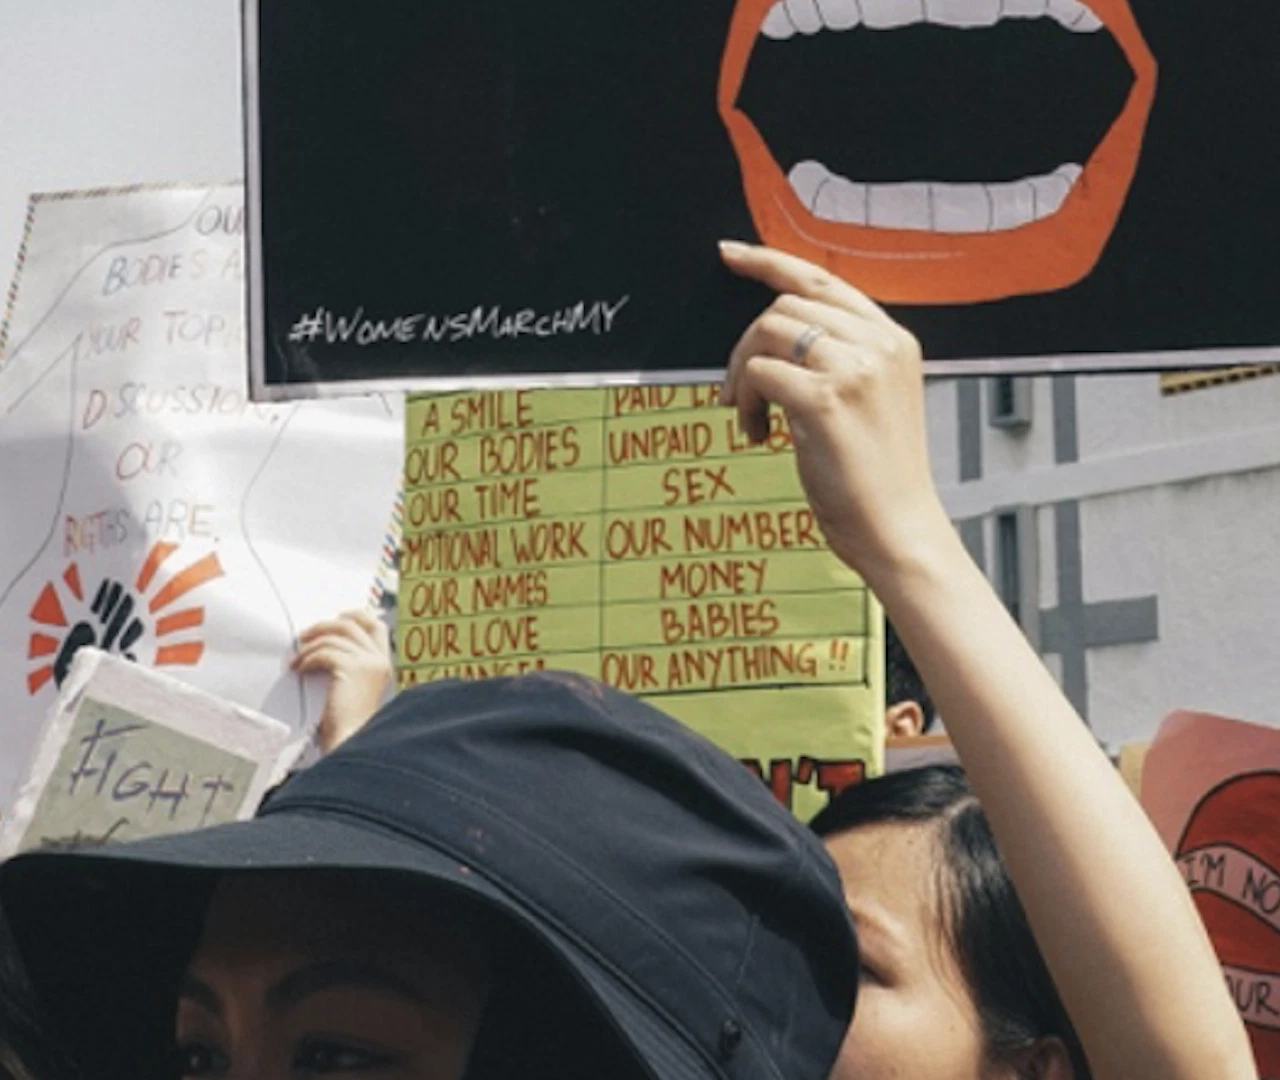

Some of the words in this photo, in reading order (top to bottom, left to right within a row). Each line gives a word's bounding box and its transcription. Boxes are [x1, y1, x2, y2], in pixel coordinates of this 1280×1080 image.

[102, 248, 209, 296] BODIES
[422, 402, 440, 437] A
[451, 389, 534, 436] SMILE
[615, 385, 678, 418] PAID
[405, 439, 462, 486] OUR
[480, 426, 580, 475] BODIES
[609, 422, 713, 464] UNPAID
[409, 488, 462, 527] OUR
[475, 478, 541, 519] TIME
[661, 466, 735, 505] SEX
[511, 521, 588, 566] WORK
[606, 516, 673, 560] OUR
[410, 577, 462, 618] OUR
[472, 570, 548, 616] NAMES
[660, 558, 767, 599] MONEY
[405, 622, 462, 663] OUR
[471, 616, 539, 657] LOVE
[659, 599, 780, 645] BABIES
[601, 652, 659, 690] OUR
[667, 642, 818, 690] ANYTHING
[69, 717, 234, 827] FIGHT
